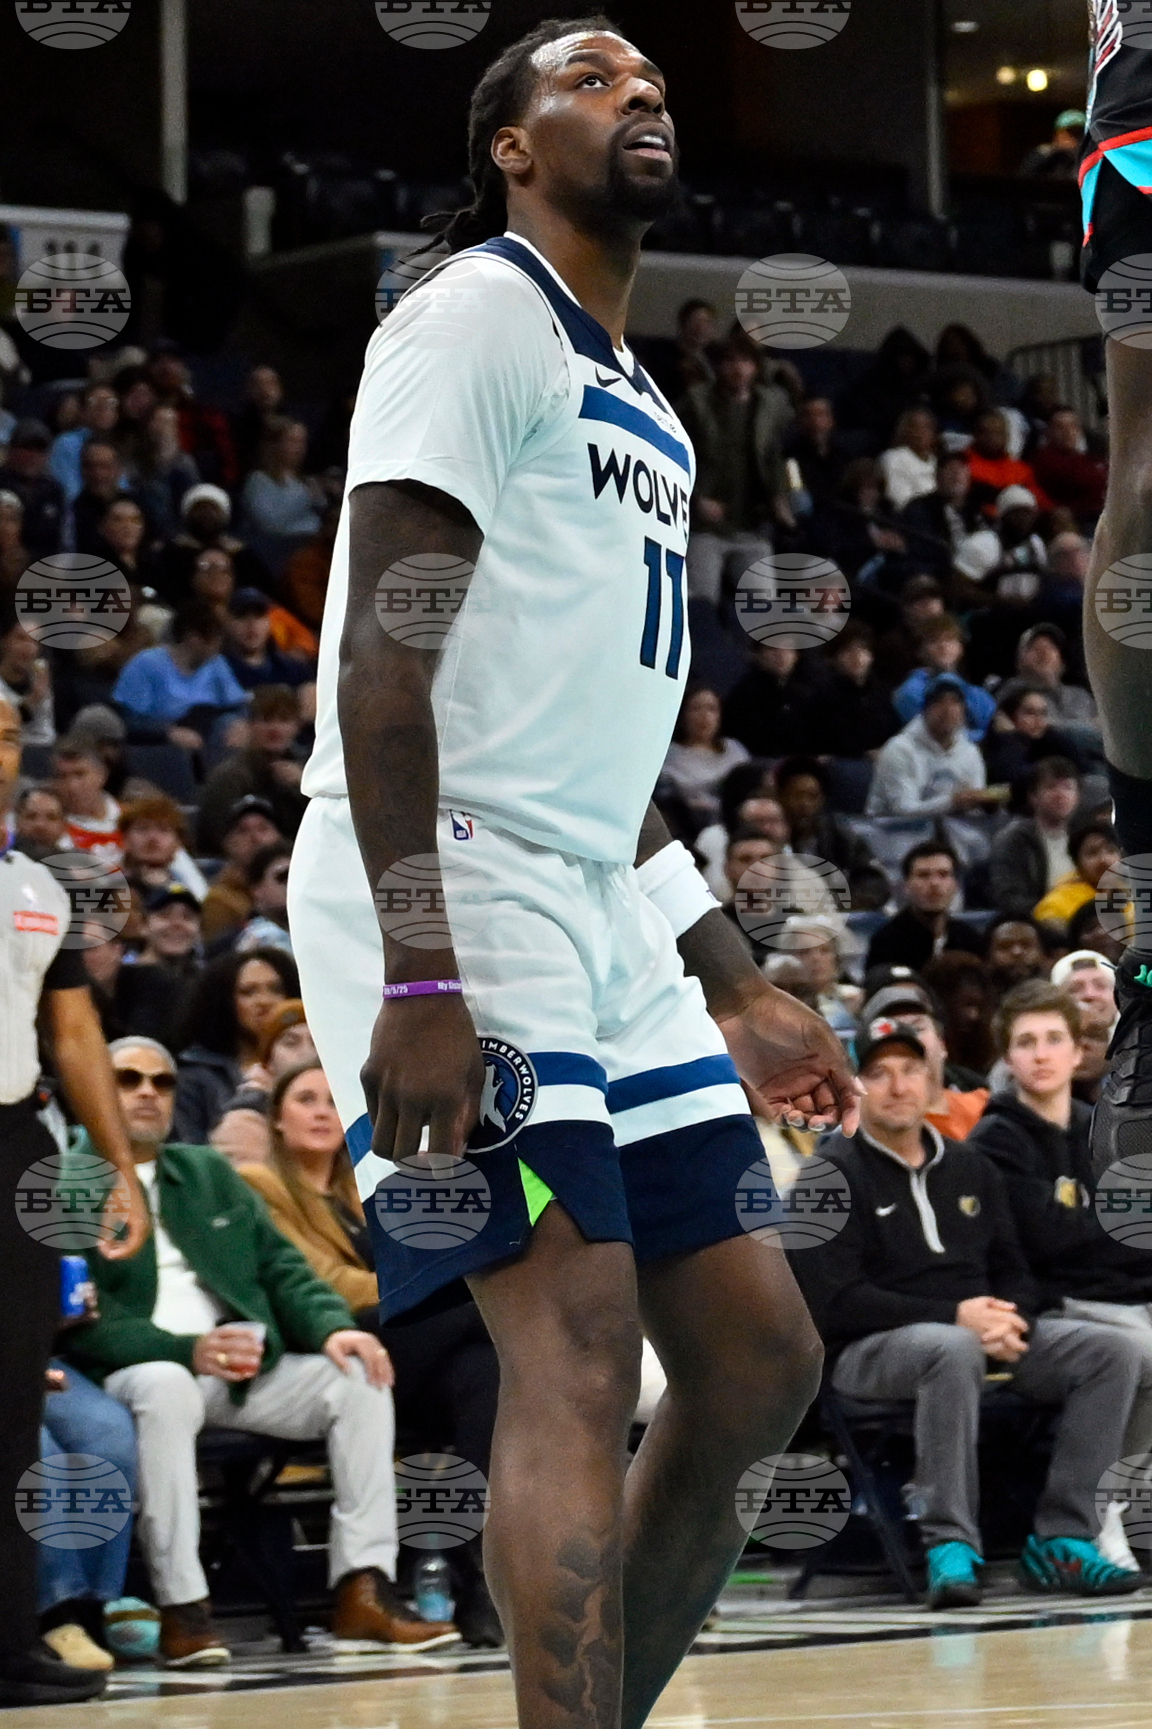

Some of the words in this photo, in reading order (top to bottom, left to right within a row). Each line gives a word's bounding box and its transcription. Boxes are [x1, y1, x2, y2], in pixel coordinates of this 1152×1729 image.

[587, 441, 688, 545] WOLVE
[640, 535, 685, 681] 11
[482, 1039, 533, 1121] IMBERWOLVES
